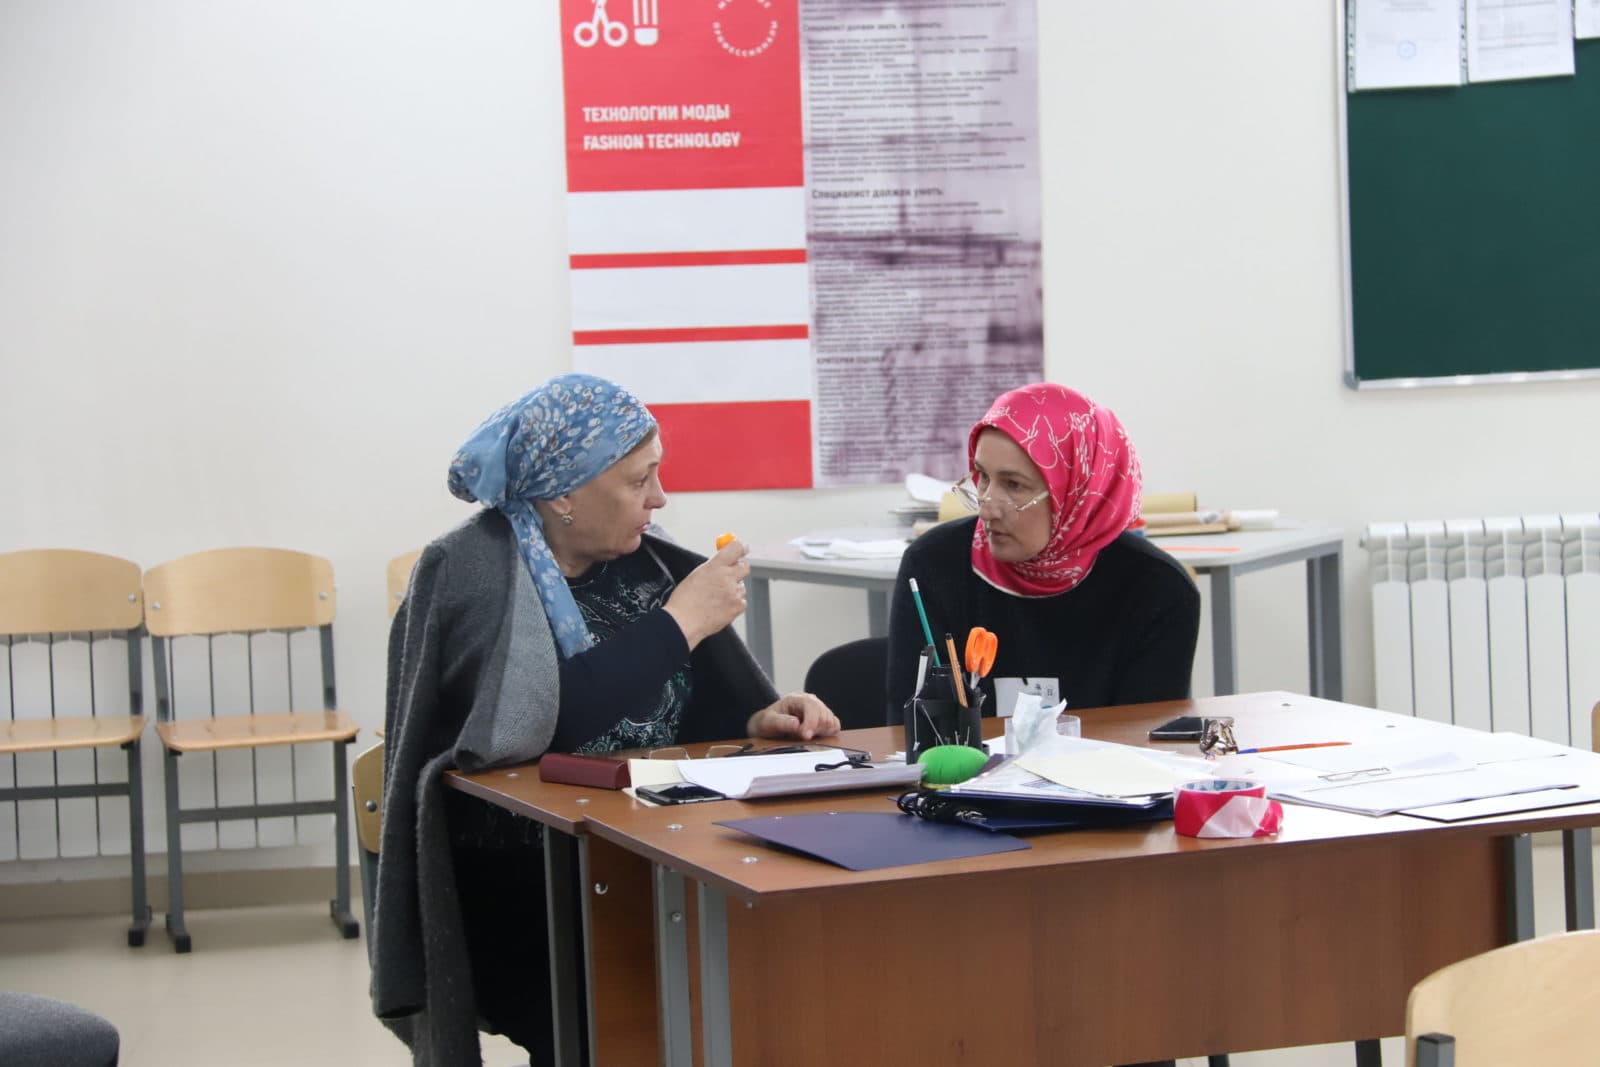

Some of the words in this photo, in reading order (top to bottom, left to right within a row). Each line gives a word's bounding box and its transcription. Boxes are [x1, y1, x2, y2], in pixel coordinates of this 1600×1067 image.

[582, 105, 679, 123] ТЕХНОЛОГИИ
[682, 104, 730, 122] МОДЫ
[583, 134, 644, 151] FASHION
[647, 132, 741, 149] TECHNOLOGY
[812, 189, 870, 200] Специалист
